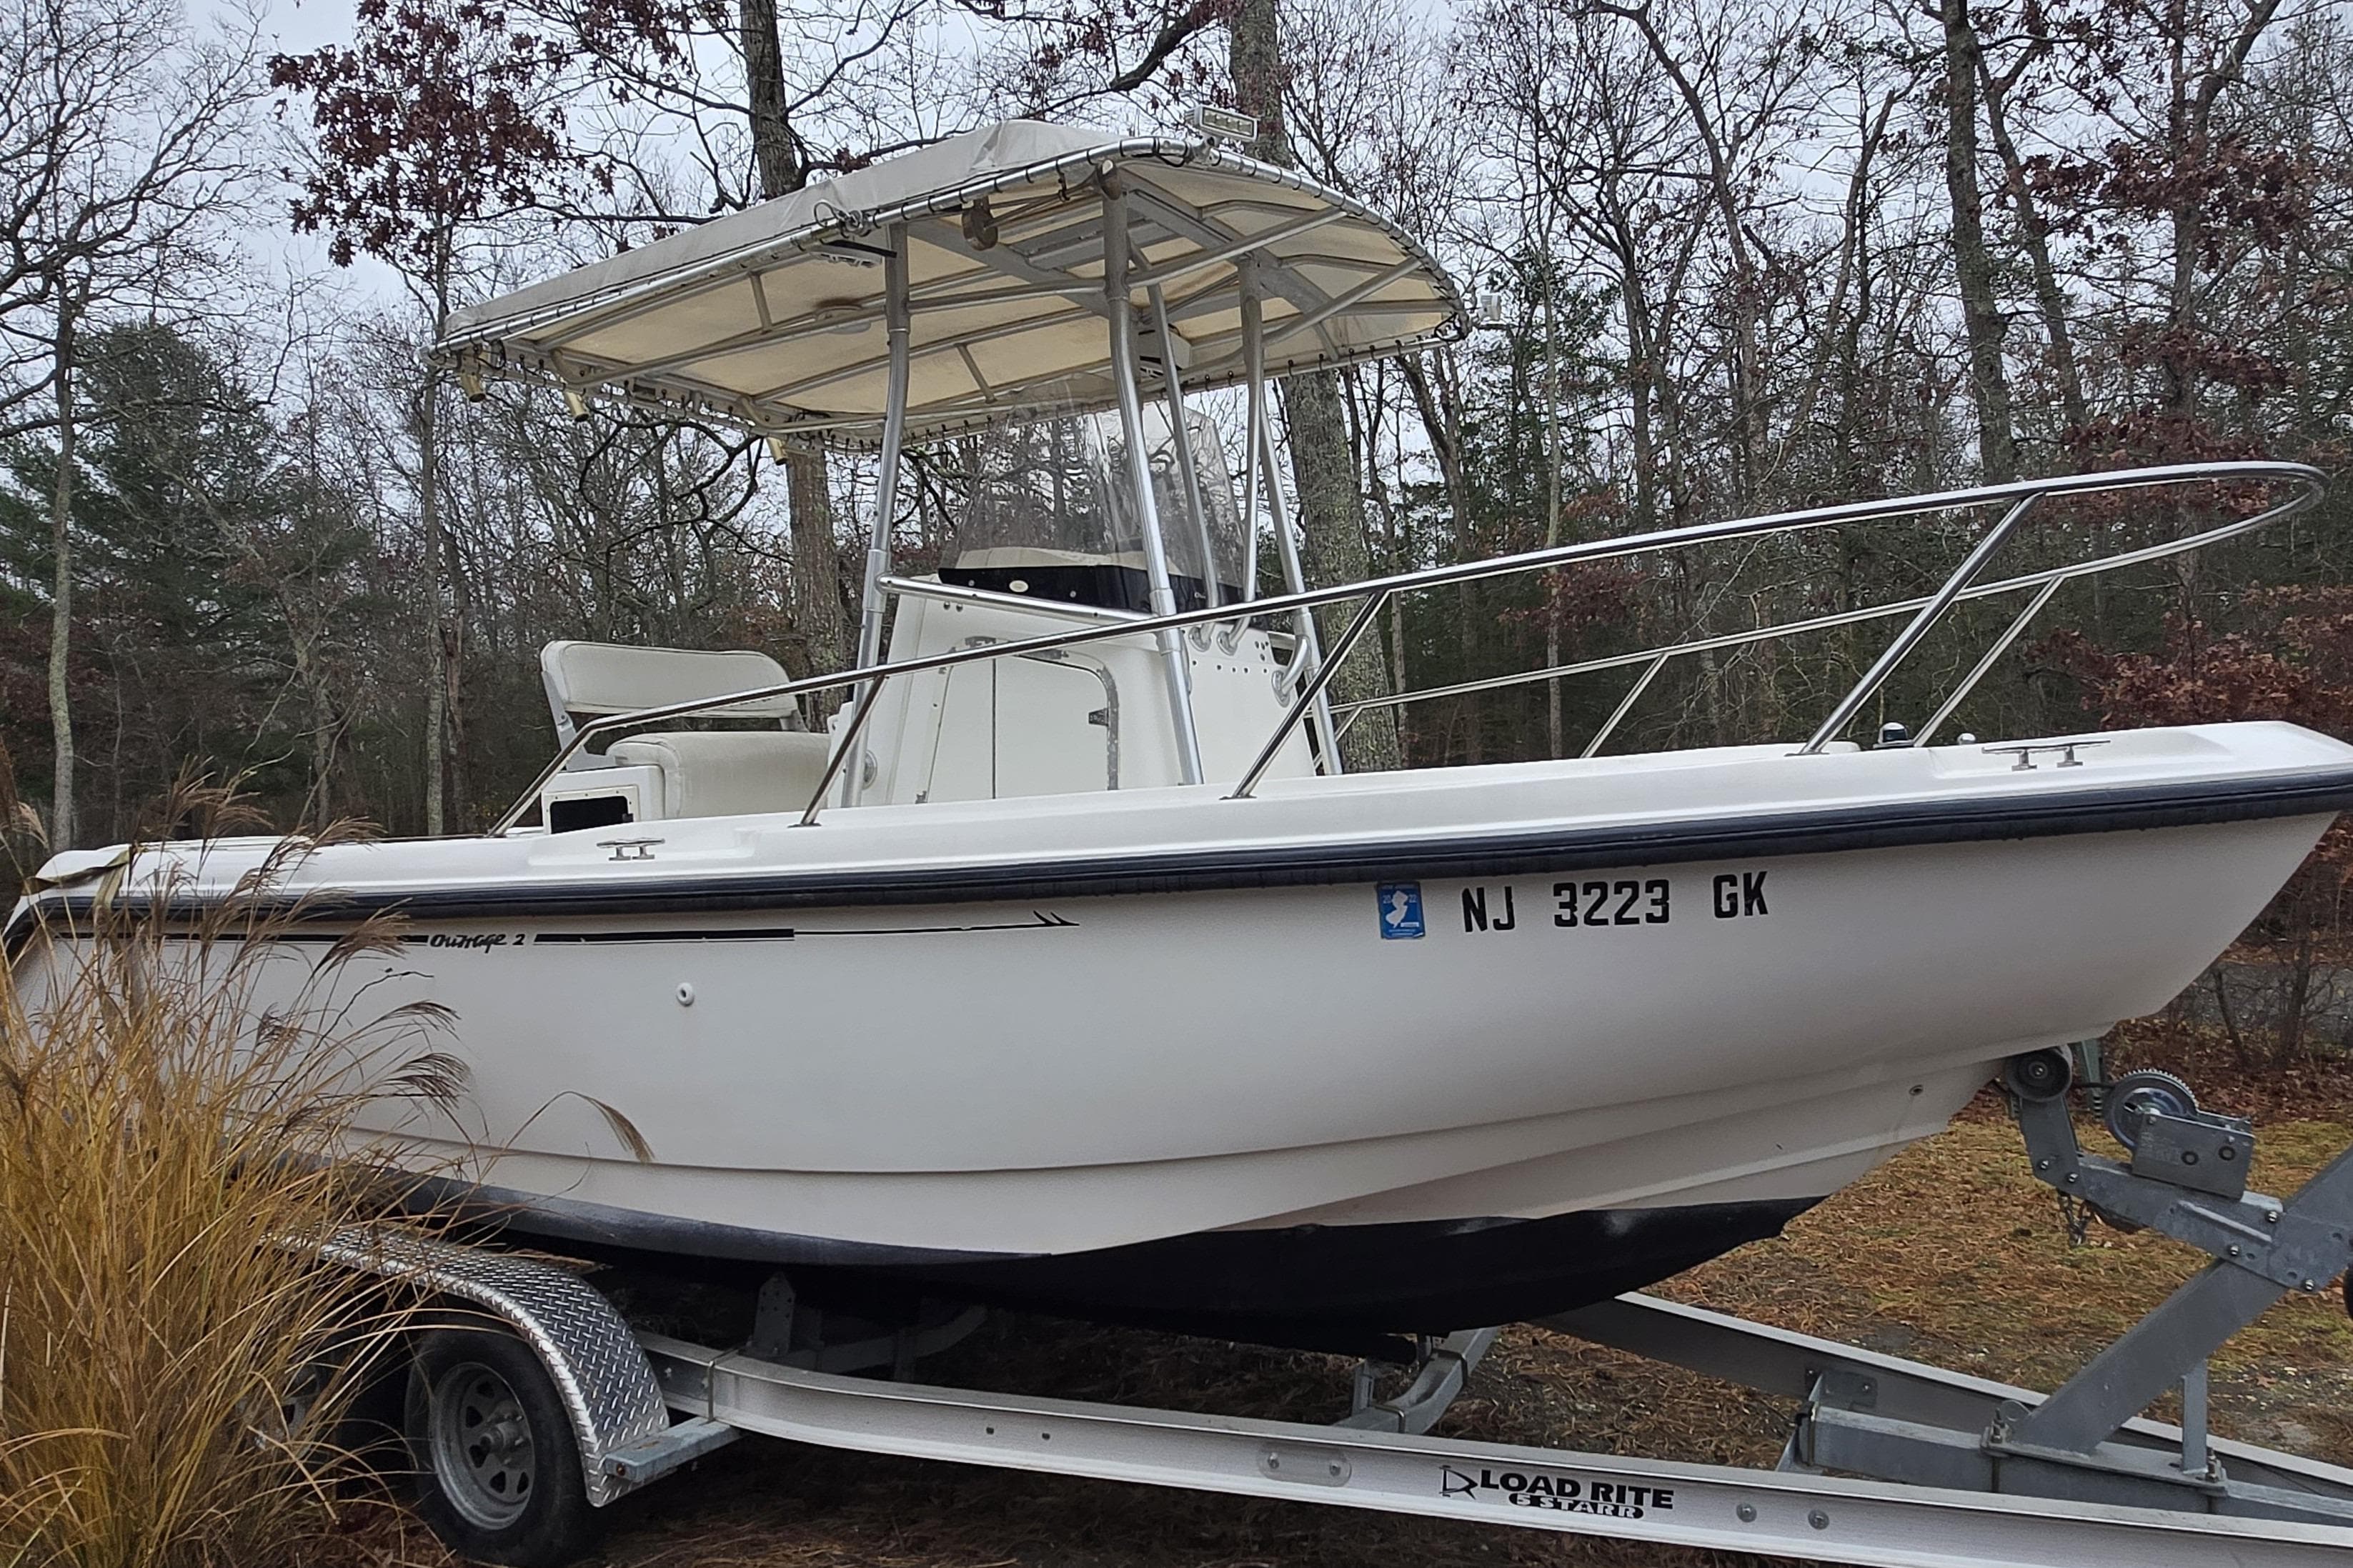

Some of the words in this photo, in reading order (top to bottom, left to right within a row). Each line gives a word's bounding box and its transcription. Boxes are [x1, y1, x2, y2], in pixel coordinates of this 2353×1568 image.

[1462, 885, 1516, 932] NJ
[1553, 879, 1670, 927] 3223
[1713, 871, 1769, 919] GK
[429, 934, 507, 954] Outrage
[1481, 1469, 1581, 1497] LOAD
[1591, 1482, 1674, 1509] RITE
[1516, 1493, 1531, 1506] 5
